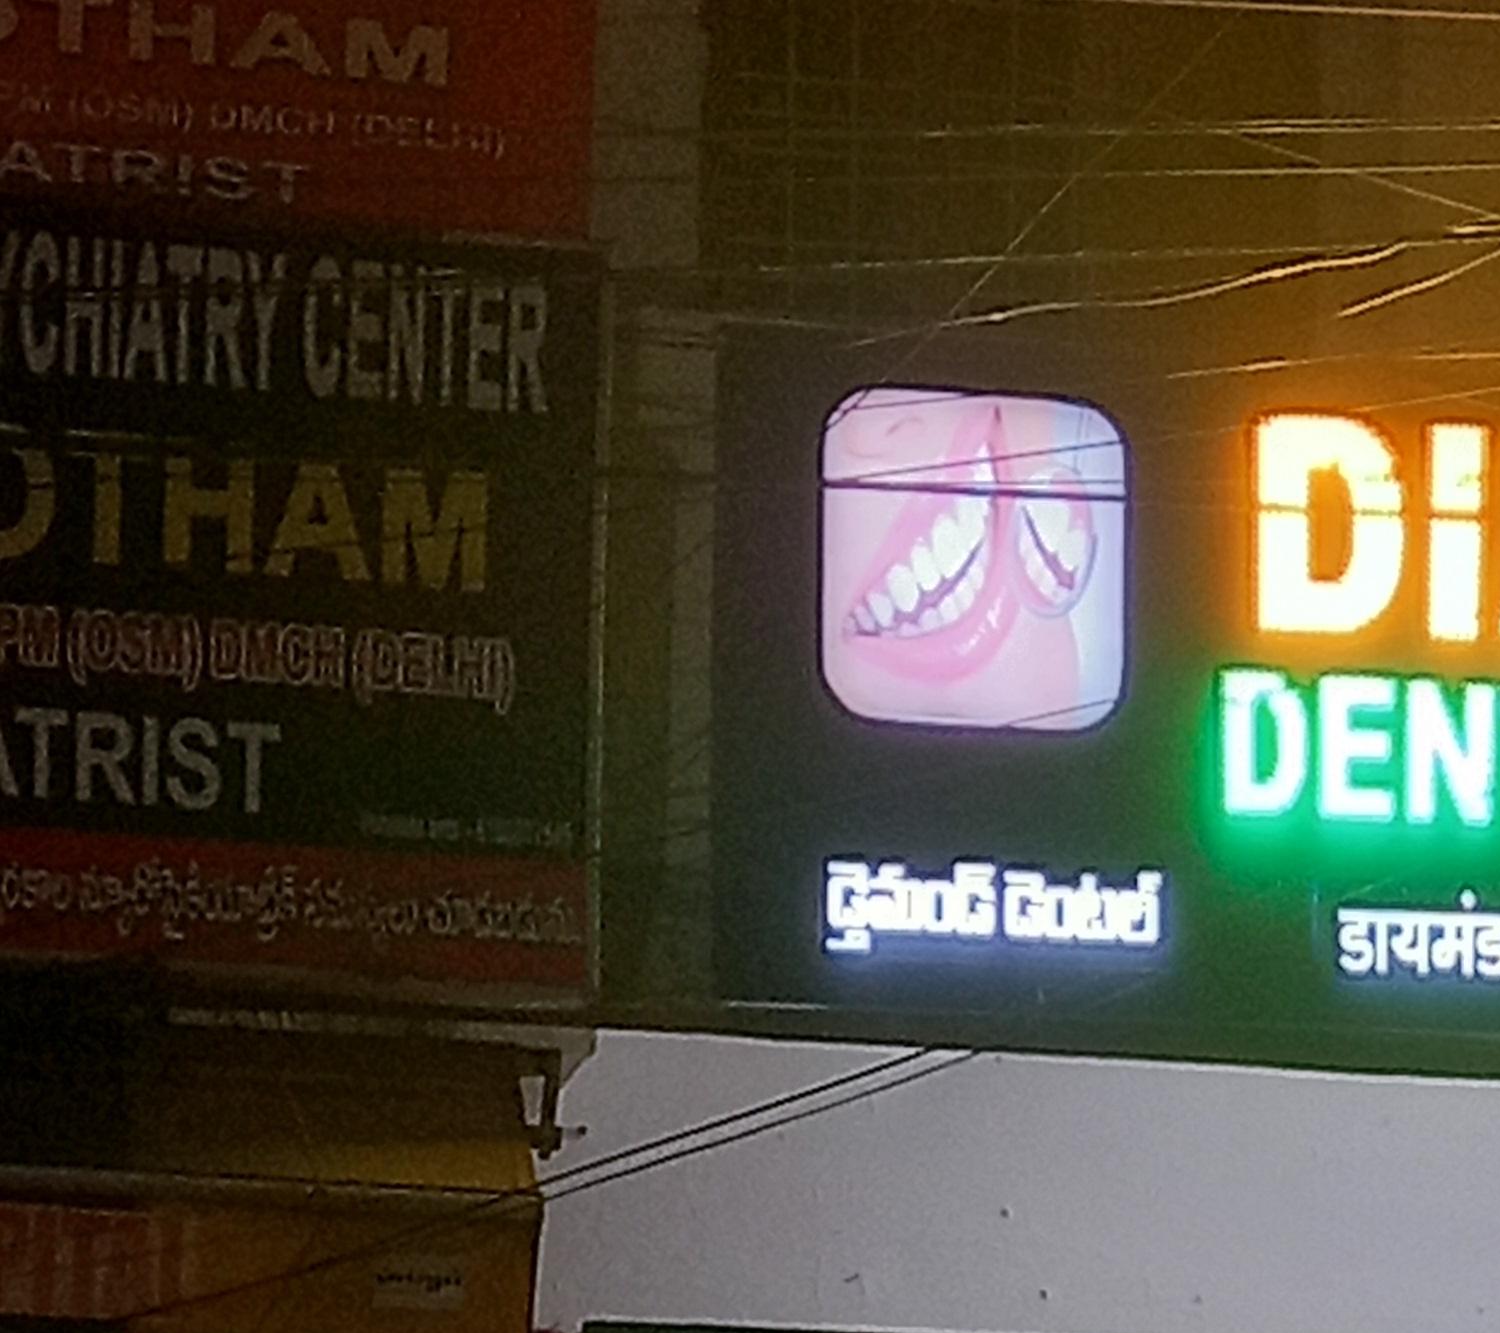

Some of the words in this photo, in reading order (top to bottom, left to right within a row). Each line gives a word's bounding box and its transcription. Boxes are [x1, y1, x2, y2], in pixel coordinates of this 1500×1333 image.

[0, 0, 450, 88] THAM
[211, 102, 336, 136] DMCH
[304, 256, 549, 413] CENTER
[66, 608, 202, 693] (OSM)
[209, 617, 348, 690] DMCH
[350, 626, 516, 716] (DELHI)
[0, 706, 283, 814] TRIST
